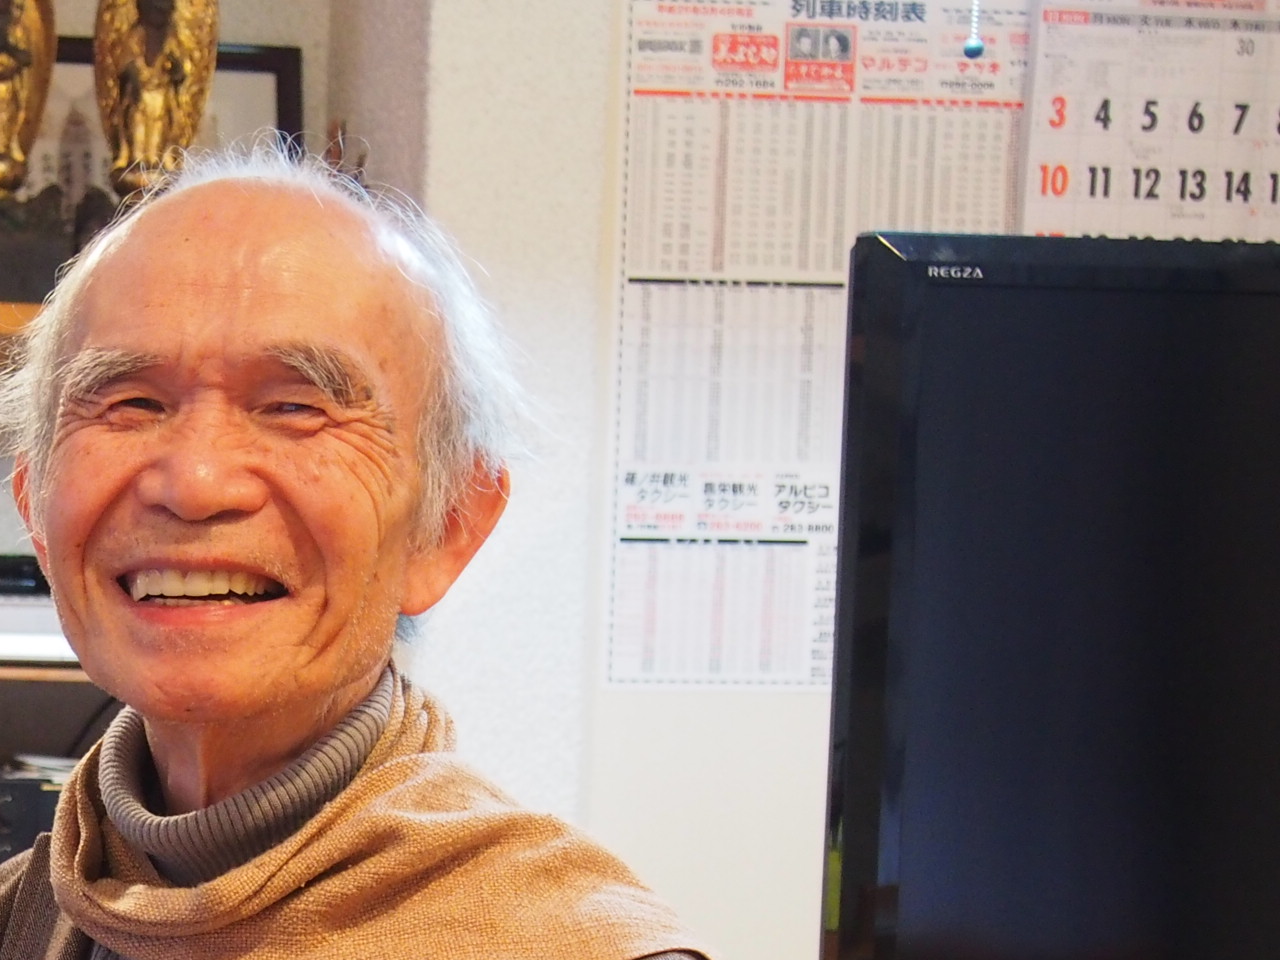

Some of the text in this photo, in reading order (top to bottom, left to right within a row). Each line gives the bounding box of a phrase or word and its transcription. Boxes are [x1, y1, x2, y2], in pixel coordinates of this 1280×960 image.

[791, 0, 927, 22] 列車時刻表
[1236, 38, 1255, 57] 30
[1049, 96, 1067, 128] 3
[1095, 98, 1112, 130] 4
[1141, 100, 1159, 132] 5
[1188, 102, 1205, 134] 6
[1233, 104, 1250, 135] 7
[1040, 164, 1069, 197] 10
[1088, 166, 1111, 198] 11
[1132, 168, 1161, 200] 12
[1179, 169, 1206, 202] 13
[1225, 171, 1251, 203] 14
[927, 265, 984, 279] REGZA
[778, 500, 834, 514] タクシー
